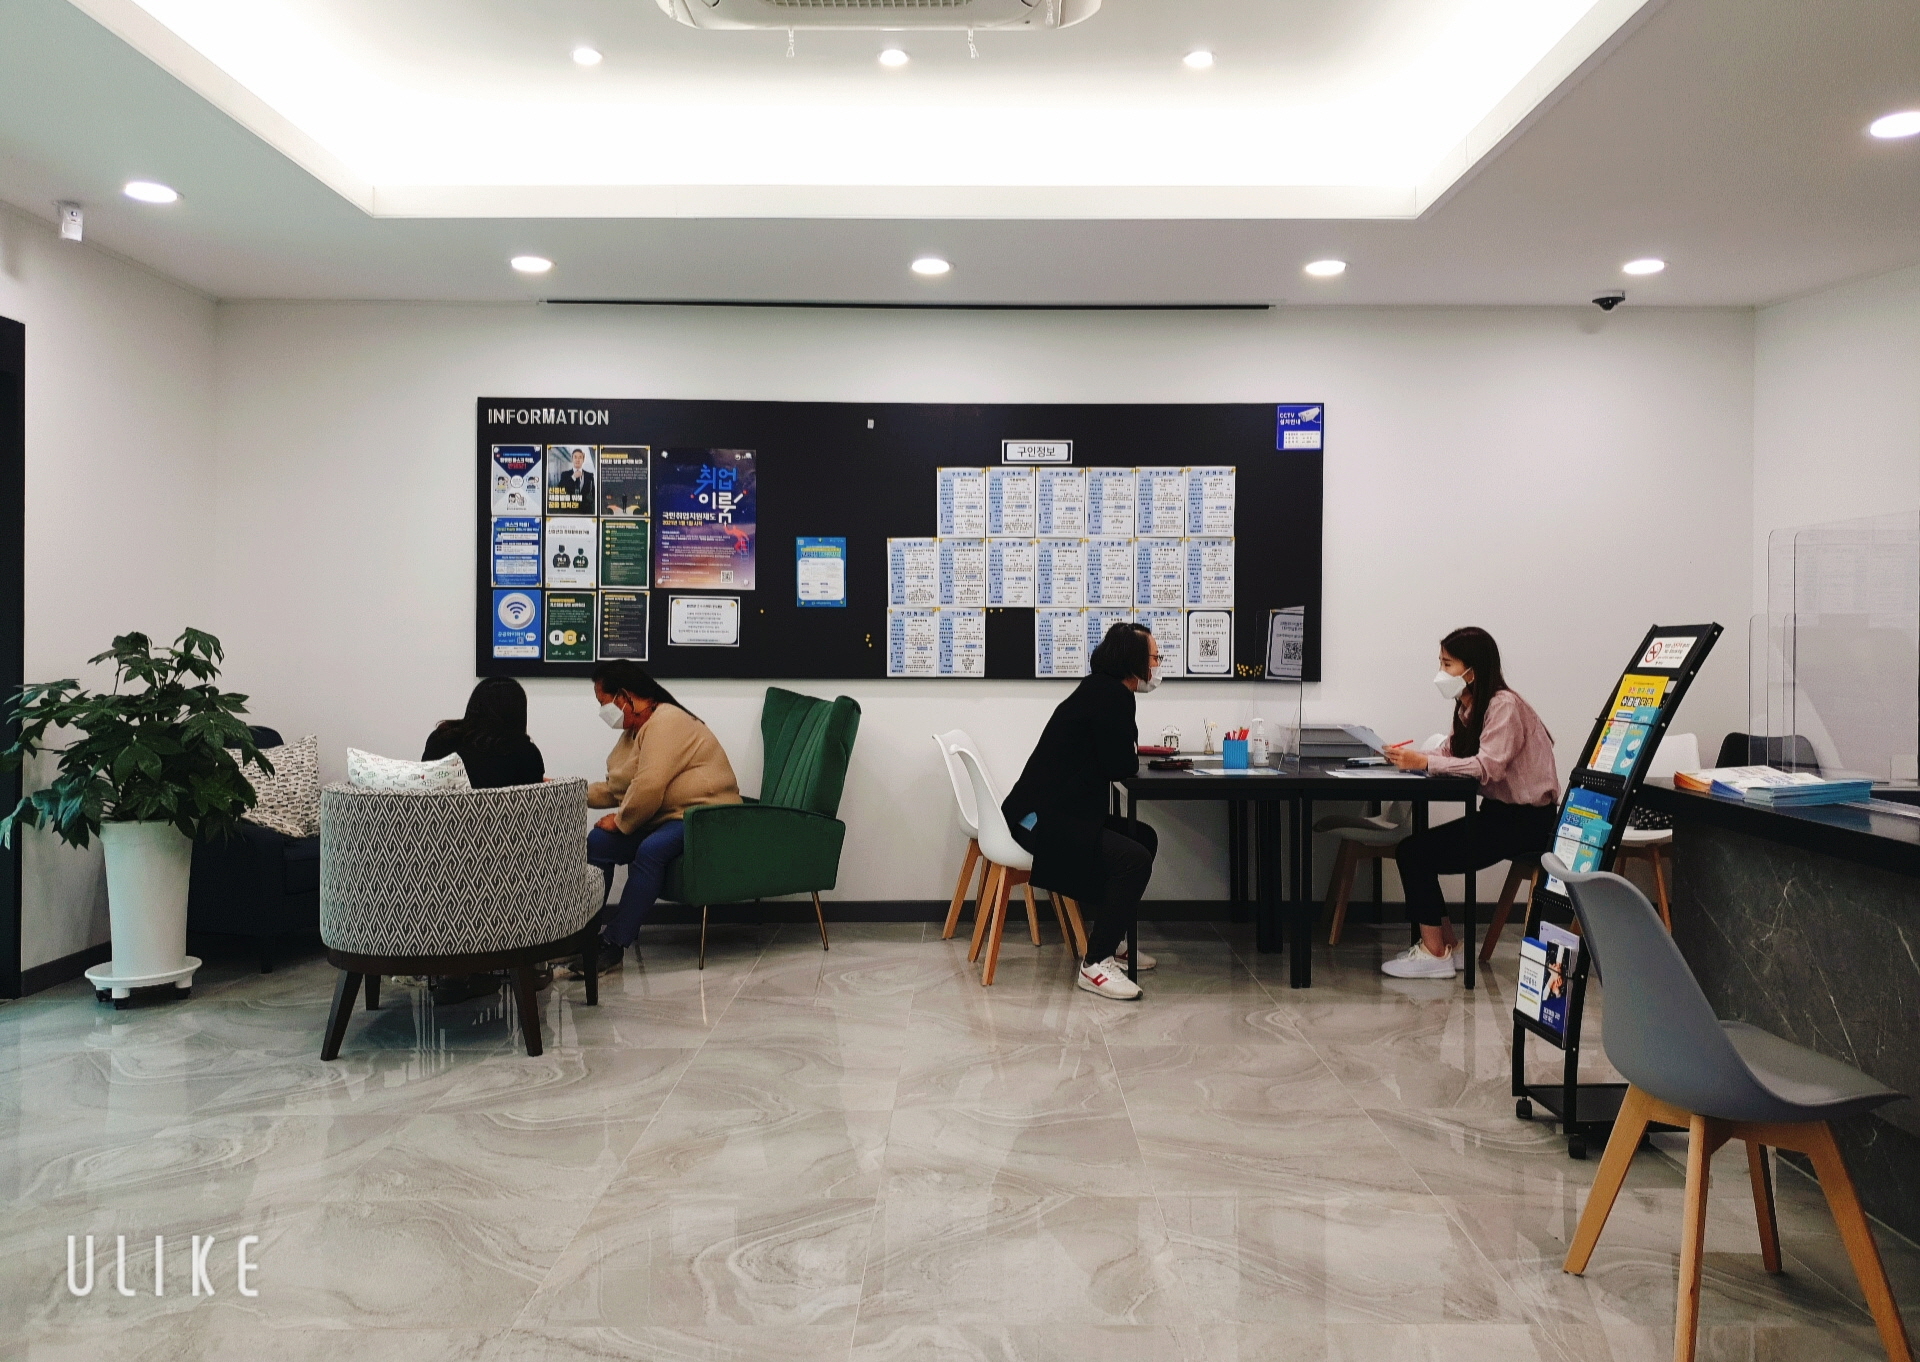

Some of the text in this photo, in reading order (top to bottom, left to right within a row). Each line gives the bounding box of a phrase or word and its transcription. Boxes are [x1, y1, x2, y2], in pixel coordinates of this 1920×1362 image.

[488, 408, 609, 426] INFORMATION
[1017, 446, 1056, 458] 구인정보
[694, 464, 737, 495] 취업
[662, 511, 716, 521] 국민취업지원제도
[698, 491, 744, 524] 이룸
